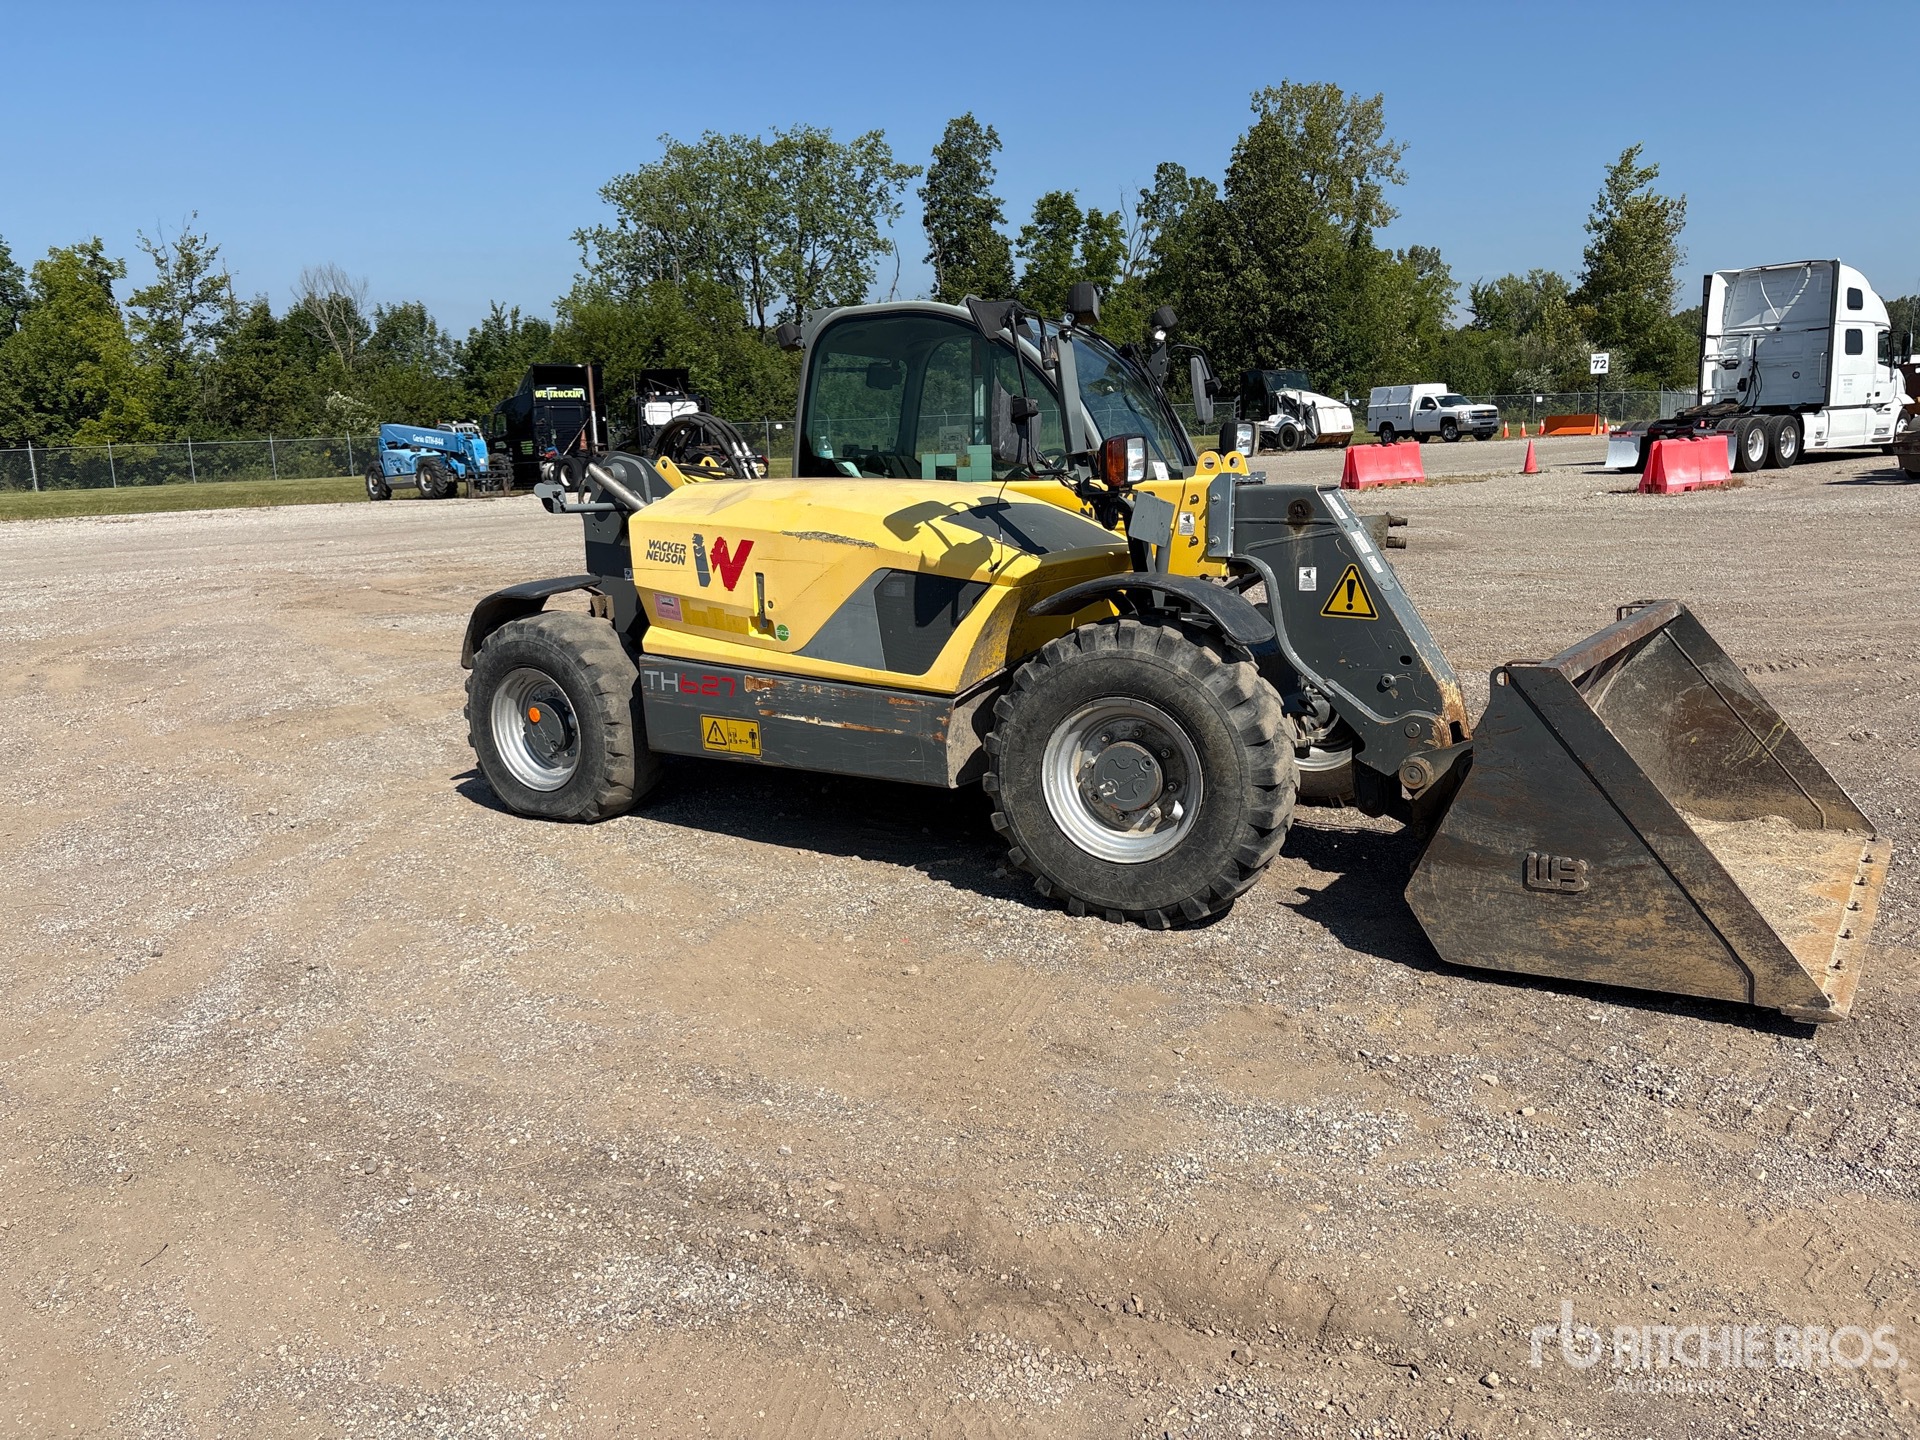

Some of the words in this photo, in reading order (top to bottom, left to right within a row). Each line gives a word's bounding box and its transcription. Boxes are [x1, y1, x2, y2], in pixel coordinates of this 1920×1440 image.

[1592, 359, 1607, 369] 72
[535, 390, 547, 398] WE
[413, 433, 425, 444] Genie
[648, 539, 687, 555] WACKER
[645, 549, 687, 566] NEUSON
[775, 629, 790, 637] ECO
[643, 669, 737, 698] TH627
